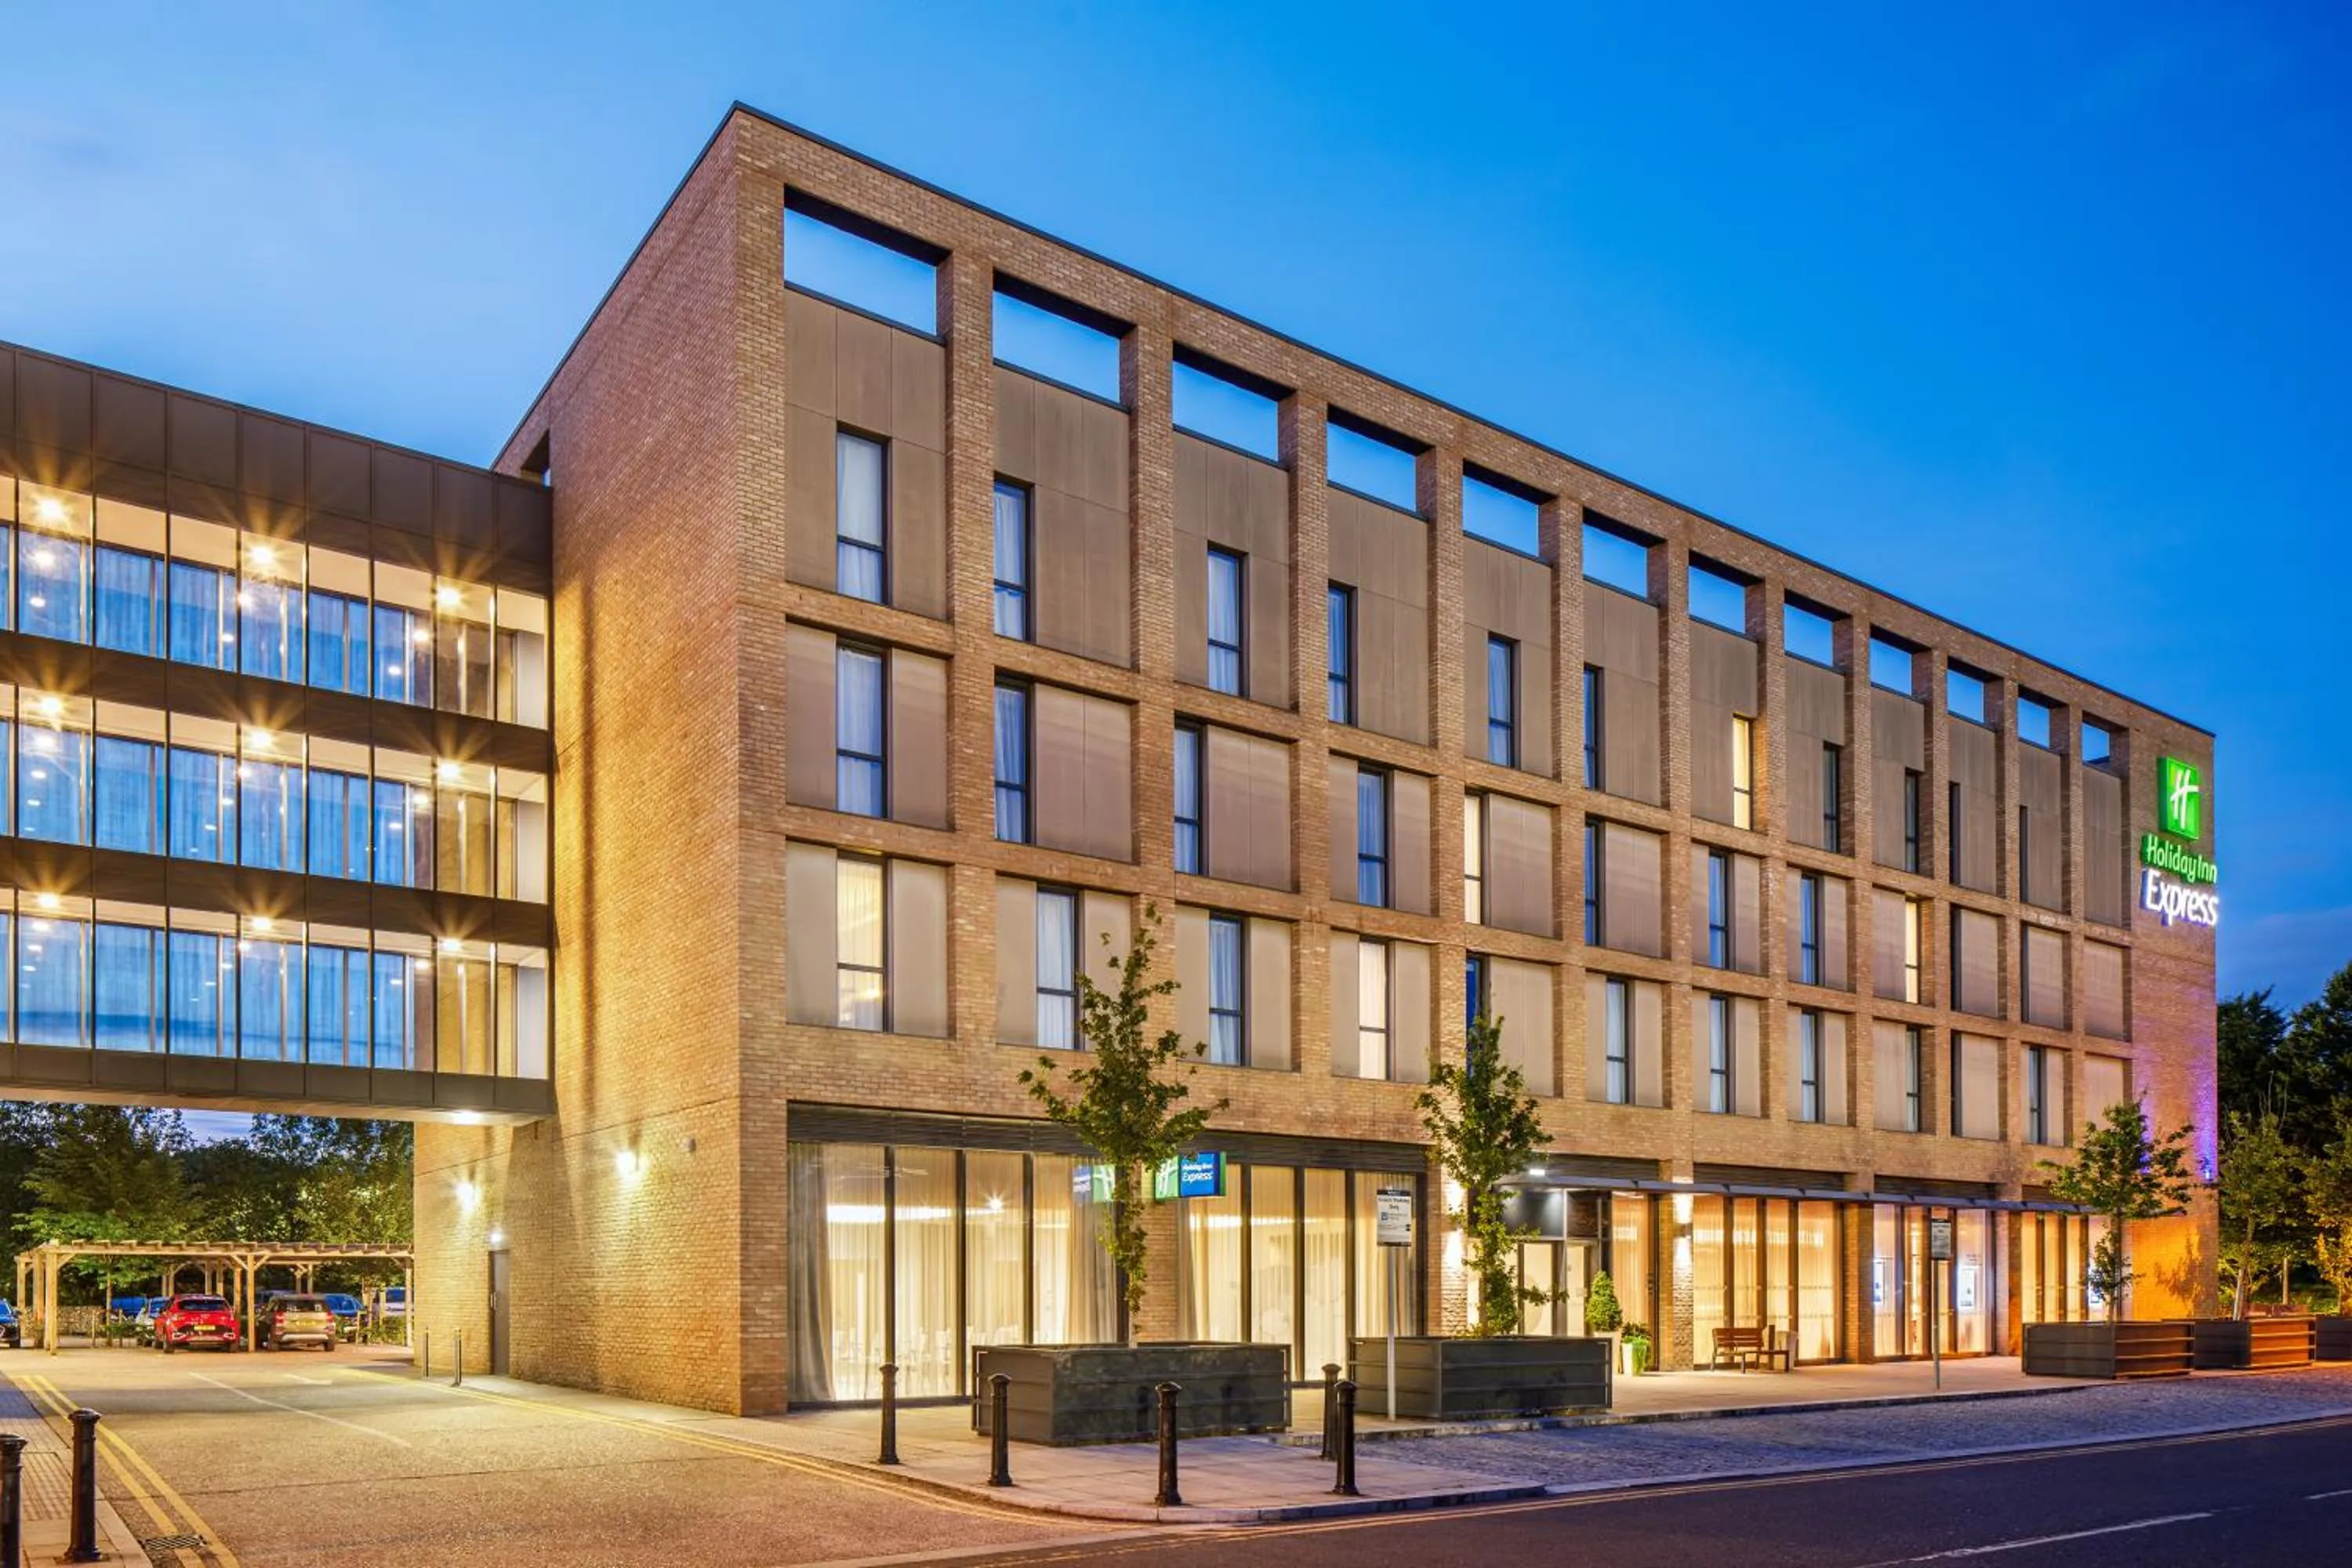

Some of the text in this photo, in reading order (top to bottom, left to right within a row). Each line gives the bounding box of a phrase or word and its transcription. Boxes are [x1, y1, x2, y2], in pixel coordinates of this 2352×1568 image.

[2146, 833, 2218, 884] Holiday Inn
[2145, 869, 2220, 927] Express
[1181, 1173, 1212, 1183] Express
